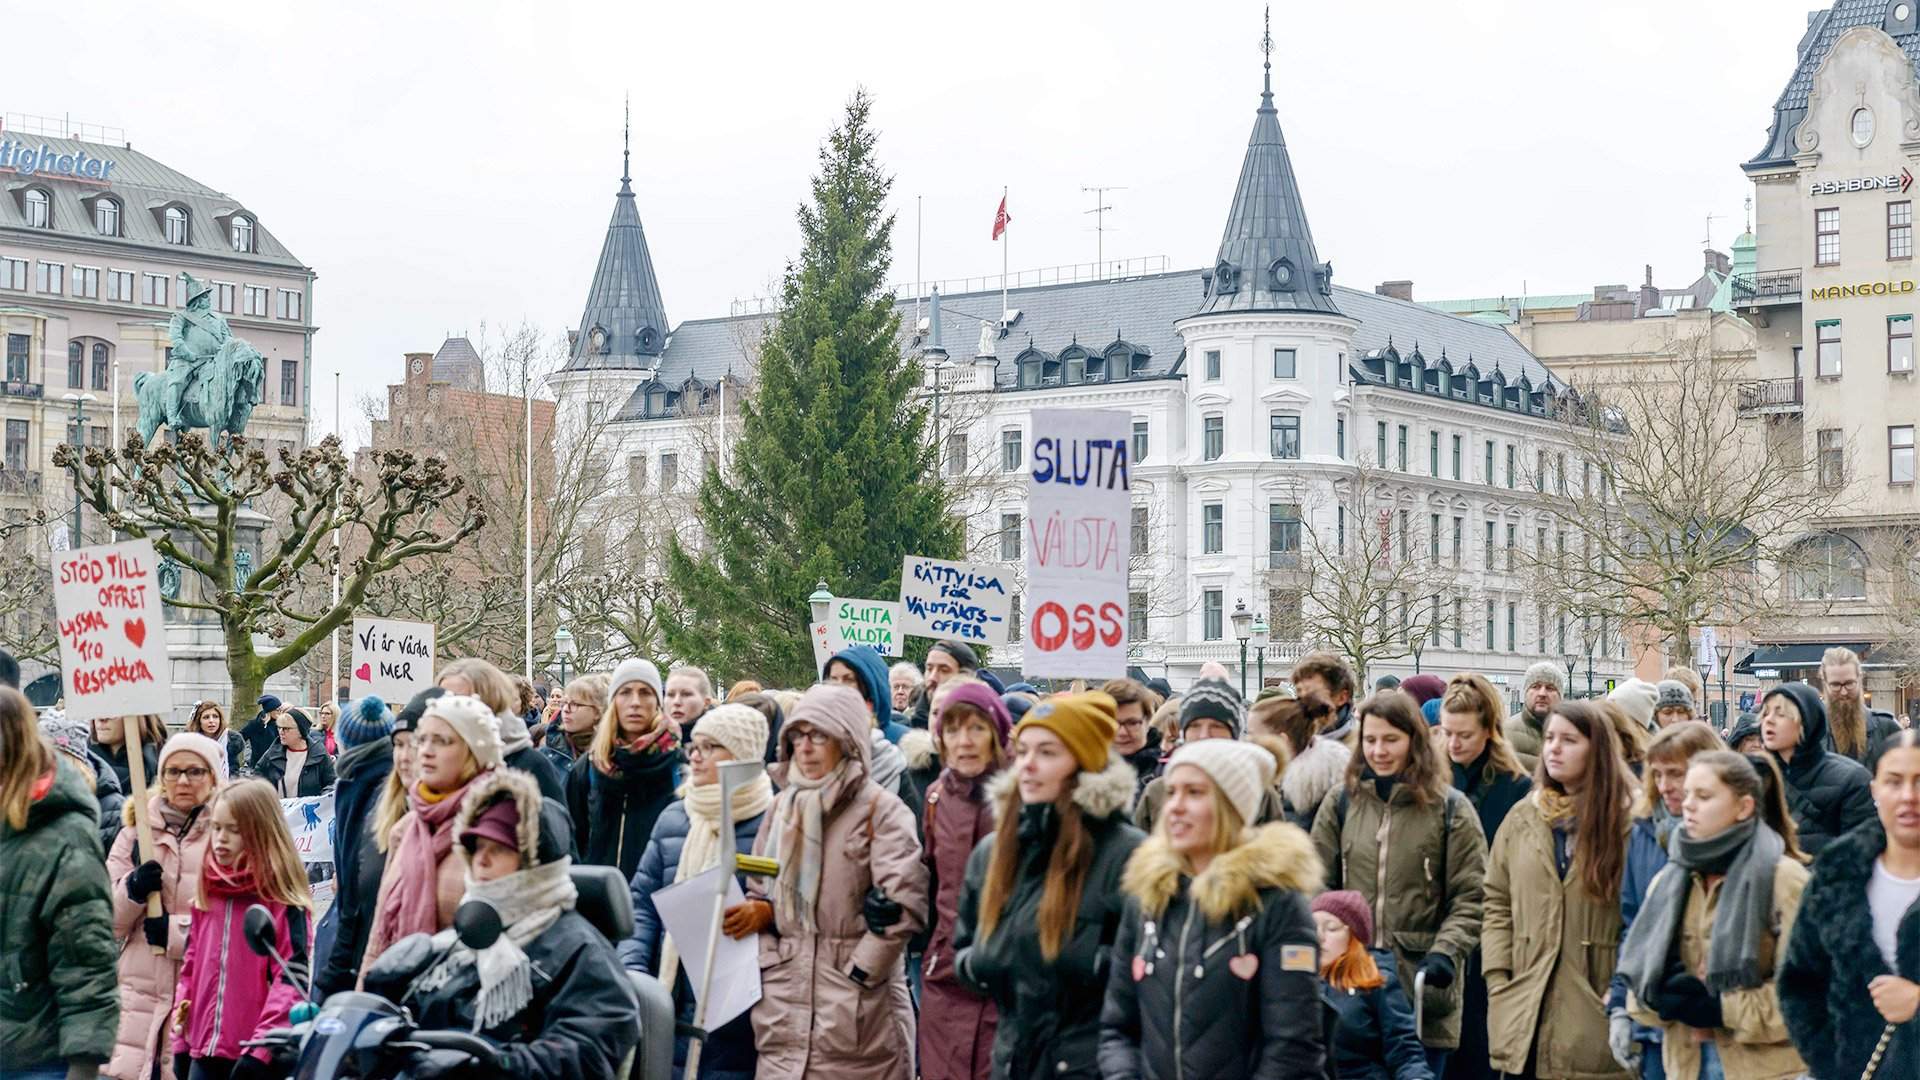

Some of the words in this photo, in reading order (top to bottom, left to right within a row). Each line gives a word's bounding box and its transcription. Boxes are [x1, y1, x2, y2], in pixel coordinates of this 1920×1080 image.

[1809, 175, 1899, 196] FISHBONE
[1811, 281, 1914, 300] MANGOLD
[1032, 437, 1129, 491] SLUTA
[1029, 510, 1120, 573] VÅLDTA
[60, 552, 104, 585] STÖD
[106, 551, 147, 580] TILL
[98, 584, 146, 609] OFFRET
[941, 584, 972, 600] FÖR
[839, 602, 892, 625] SLUTA
[905, 595, 1002, 623] VÅLDTÄKTS-
[359, 625, 375, 652] Vi
[381, 632, 395, 652] är
[840, 622, 892, 644] VÅLDTA
[932, 620, 986, 639] OFFER
[1030, 601, 1124, 652] OSS
[73, 657, 154, 695] Respektera
[380, 661, 414, 681] MER
